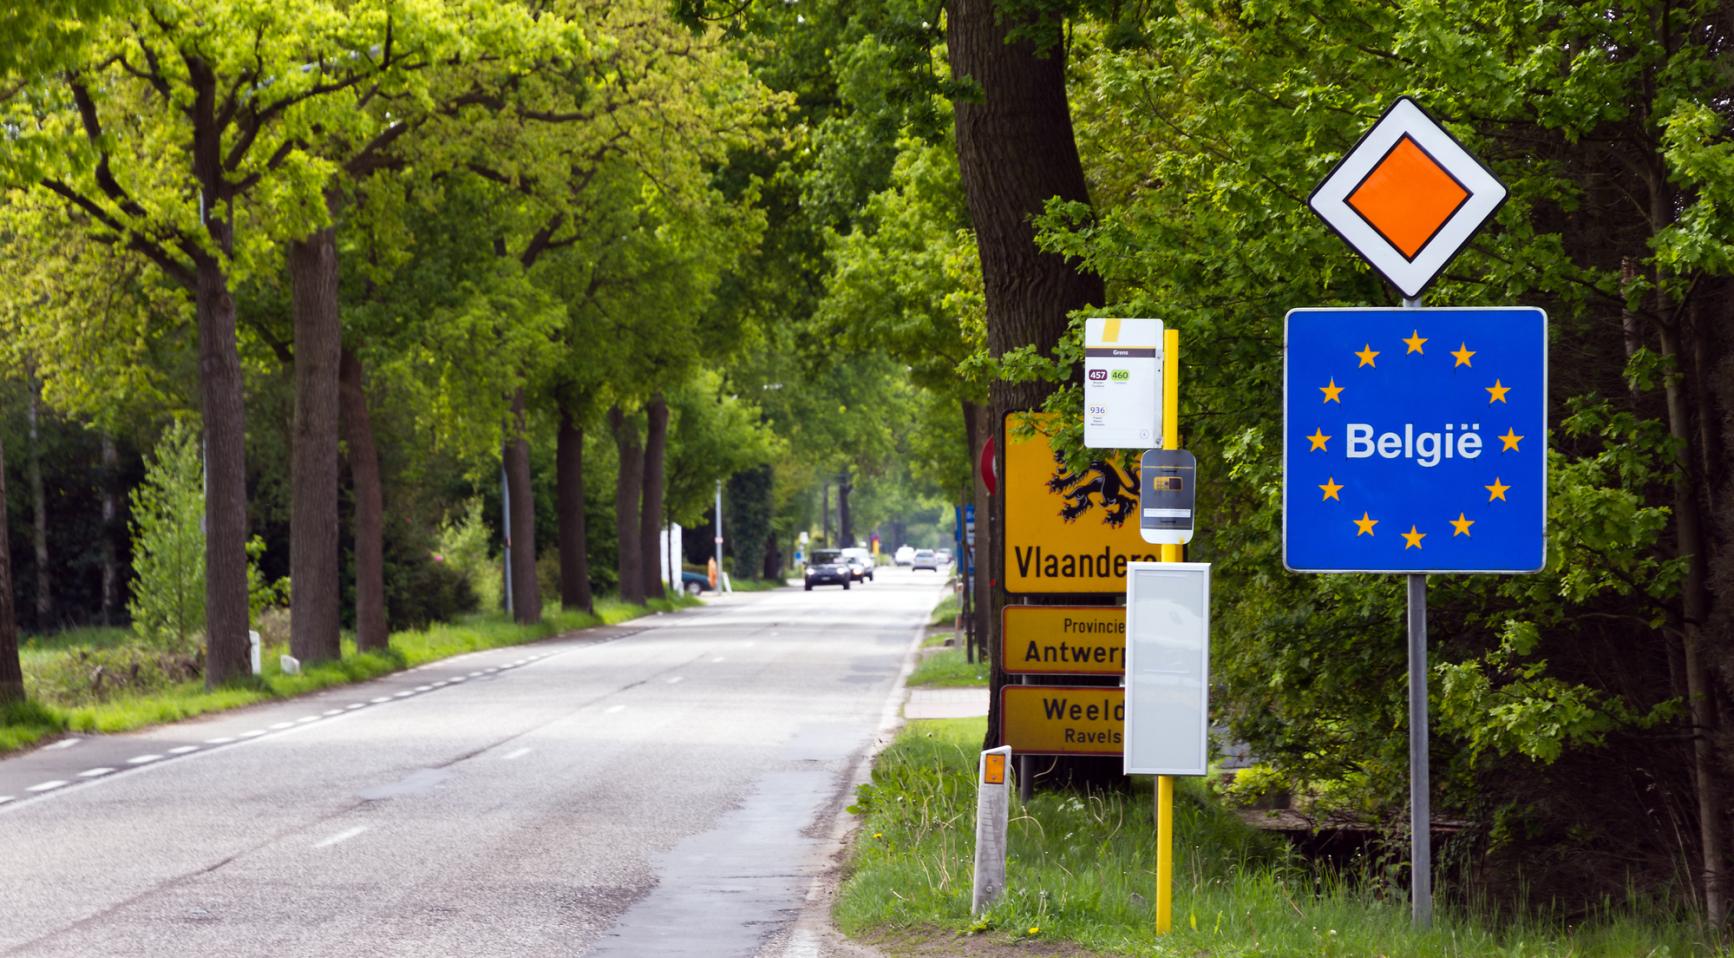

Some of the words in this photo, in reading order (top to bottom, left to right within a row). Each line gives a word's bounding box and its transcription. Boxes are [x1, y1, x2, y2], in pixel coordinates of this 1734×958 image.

[1090, 371, 1106, 379] 457
[1112, 371, 1129, 379] 460
[1090, 406, 1105, 414] 936
[1346, 423, 1482, 468] België
[1015, 545, 1157, 578] Vlaande
[1064, 618, 1125, 634] Provincie
[1025, 640, 1126, 669] Antwer
[1065, 728, 1122, 744] Ravels
